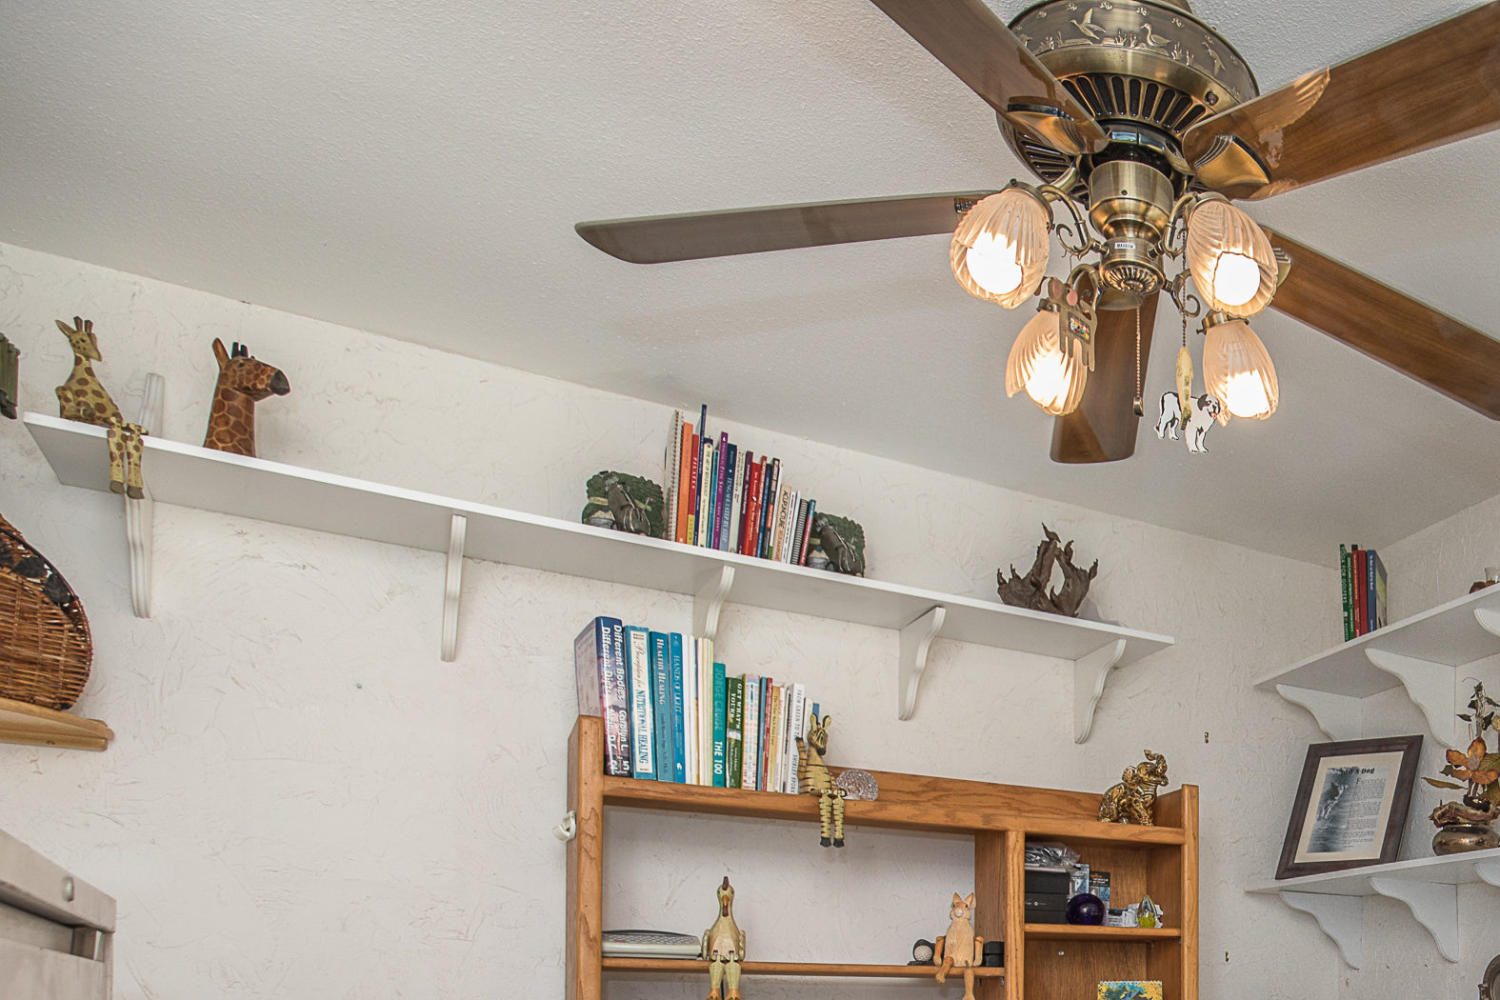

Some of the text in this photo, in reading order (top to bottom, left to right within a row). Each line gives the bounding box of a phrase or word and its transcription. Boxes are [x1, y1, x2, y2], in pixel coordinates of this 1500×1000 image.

[778, 490, 789, 529] ACUPUNCTURE
[602, 626, 612, 668] Different
[613, 624, 626, 700] Different Bodies
[656, 638, 665, 670] HEALTHY
[658, 672, 667, 704] HEALING
[619, 710, 628, 742] Carolyn
[636, 689, 647, 733] NUTRITIONAL
[638, 734, 649, 764] HEALING
[714, 741, 723, 775] THE 100
